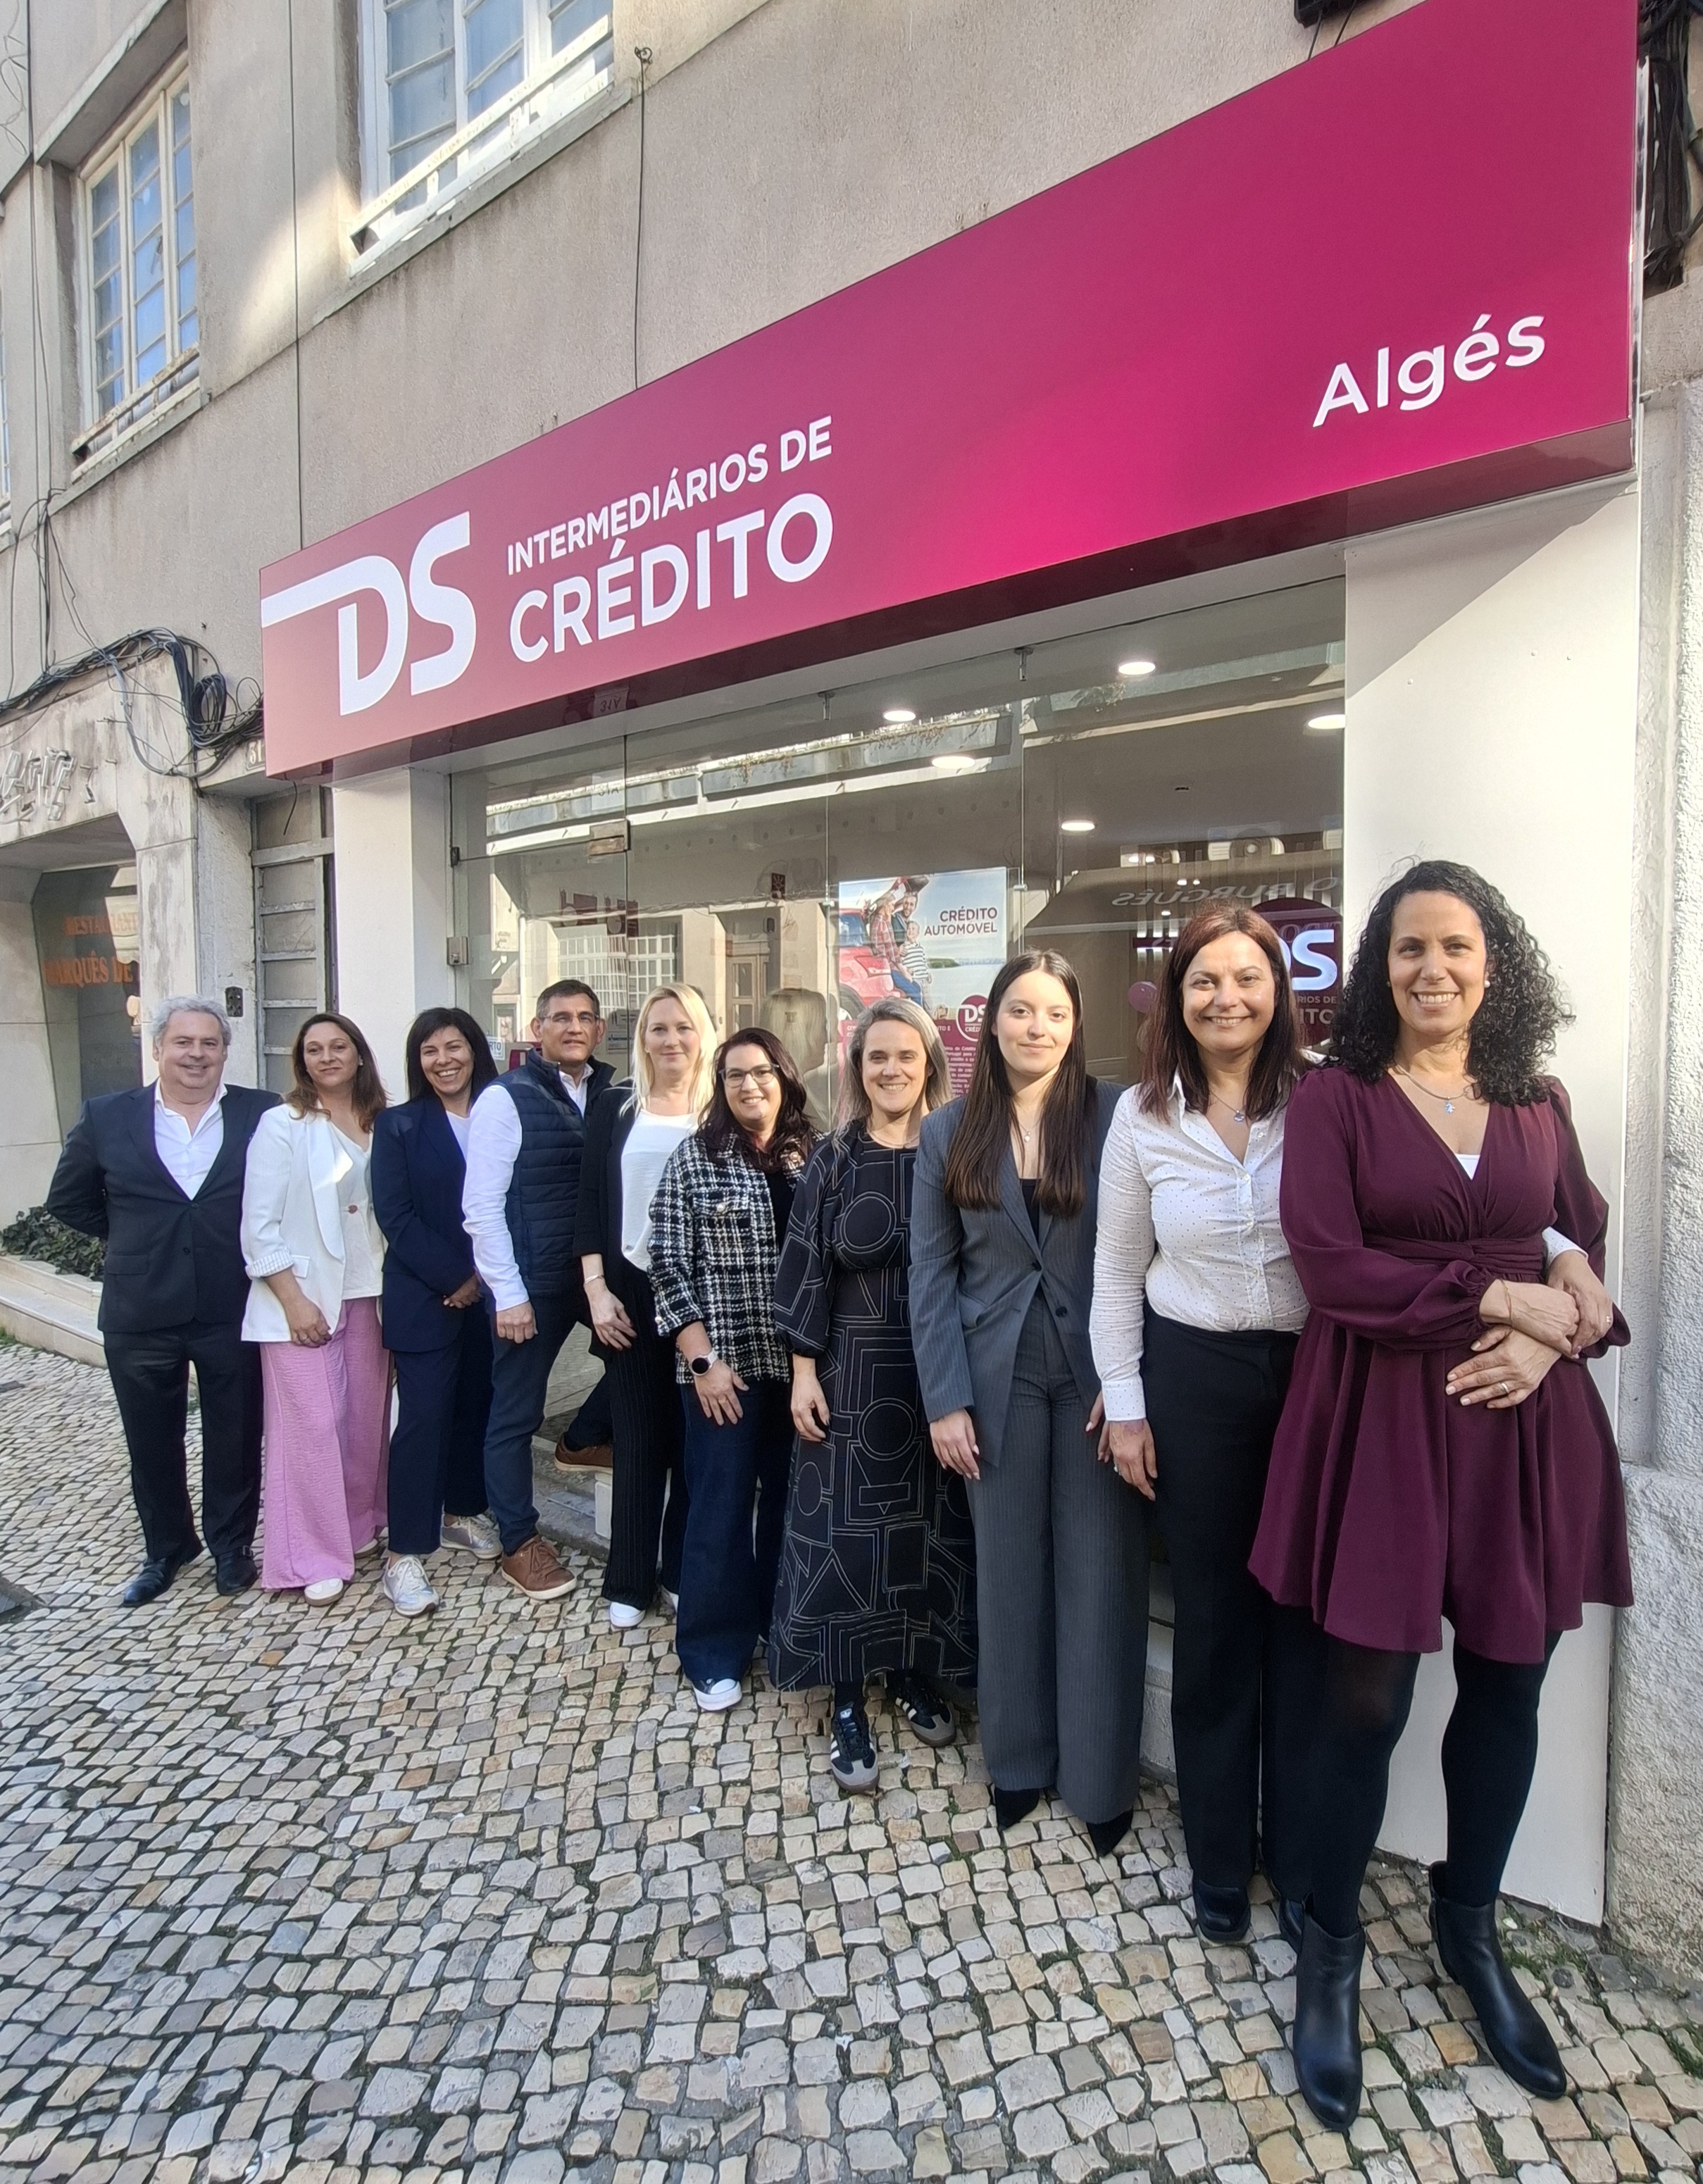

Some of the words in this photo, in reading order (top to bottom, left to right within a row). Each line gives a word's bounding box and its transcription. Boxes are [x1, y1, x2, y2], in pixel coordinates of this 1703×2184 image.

[1312, 313, 1545, 428] Algés
[507, 442, 768, 576] INTERMEDIÁRIOS
[780, 416, 832, 473] DE
[261, 511, 477, 716] DS
[509, 492, 833, 663] CRÉDITO
[924, 921, 998, 937] AUTOMÓVEL
[940, 906, 998, 923] CRÉDITO
